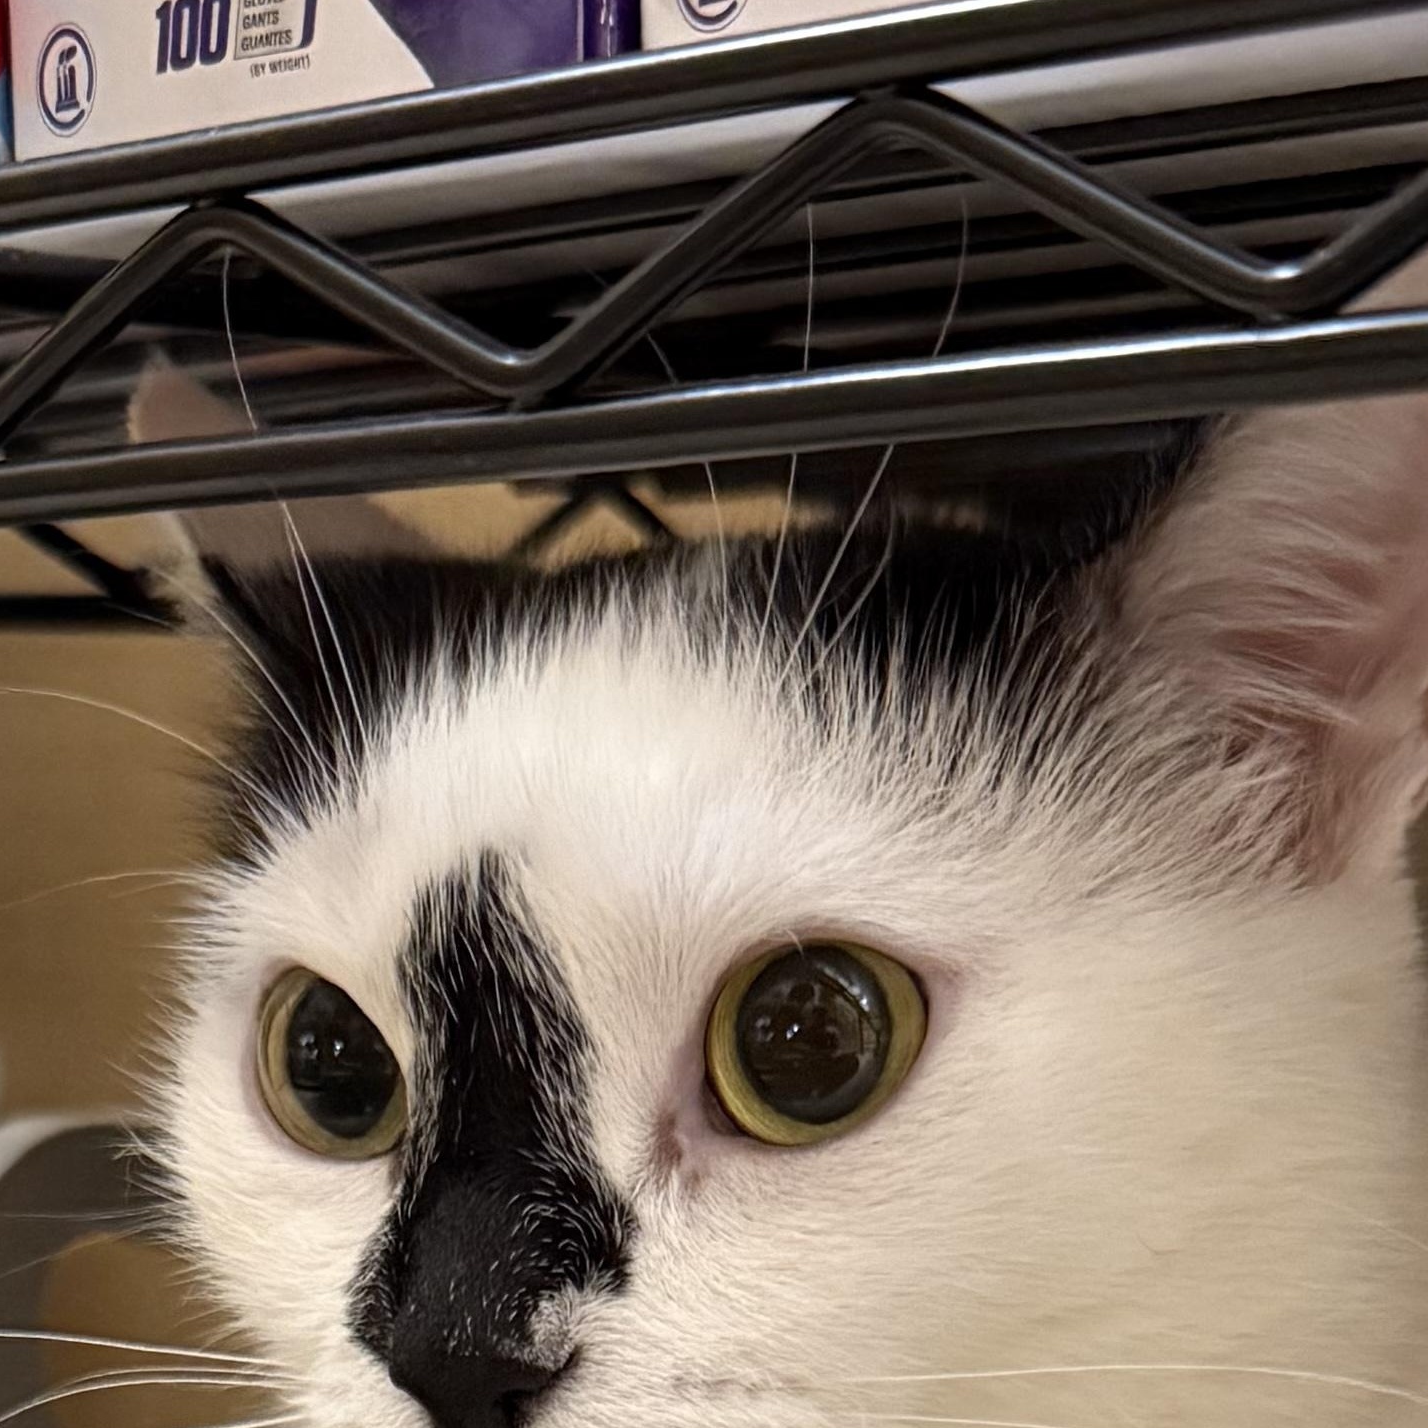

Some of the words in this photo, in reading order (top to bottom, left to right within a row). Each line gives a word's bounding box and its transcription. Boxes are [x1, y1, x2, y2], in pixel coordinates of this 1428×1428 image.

[242, 10, 280, 30] GANTS
[155, 0, 232, 75] 100
[240, 29, 293, 51] GUANTES
[249, 61, 267, 79] (BY
[268, 54, 311, 75] WEIGHT)
